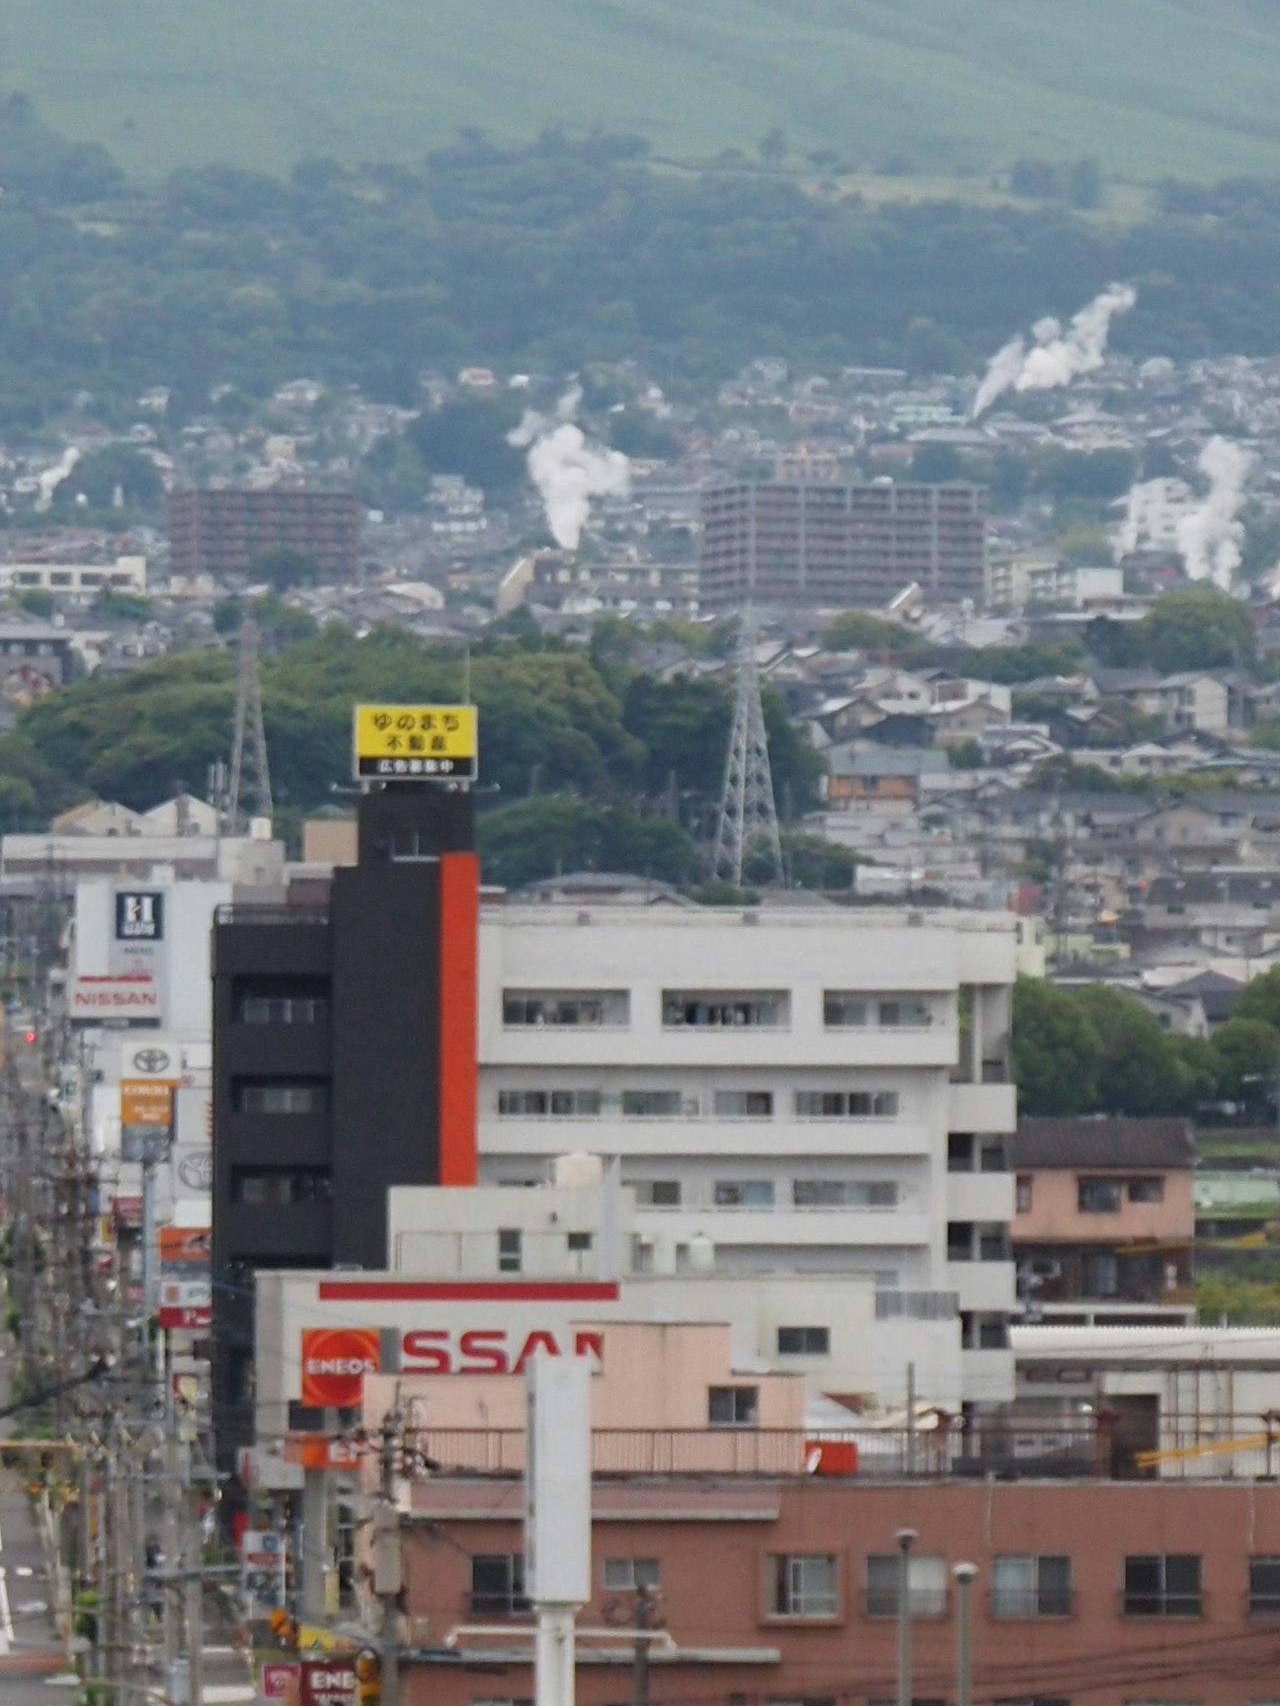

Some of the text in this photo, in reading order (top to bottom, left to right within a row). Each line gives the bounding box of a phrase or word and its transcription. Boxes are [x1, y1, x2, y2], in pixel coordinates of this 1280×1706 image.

[373, 712, 460, 731] ゆのまち
[74, 993, 157, 1006] NISSAN
[307, 1358, 375, 1375] ENEOS
